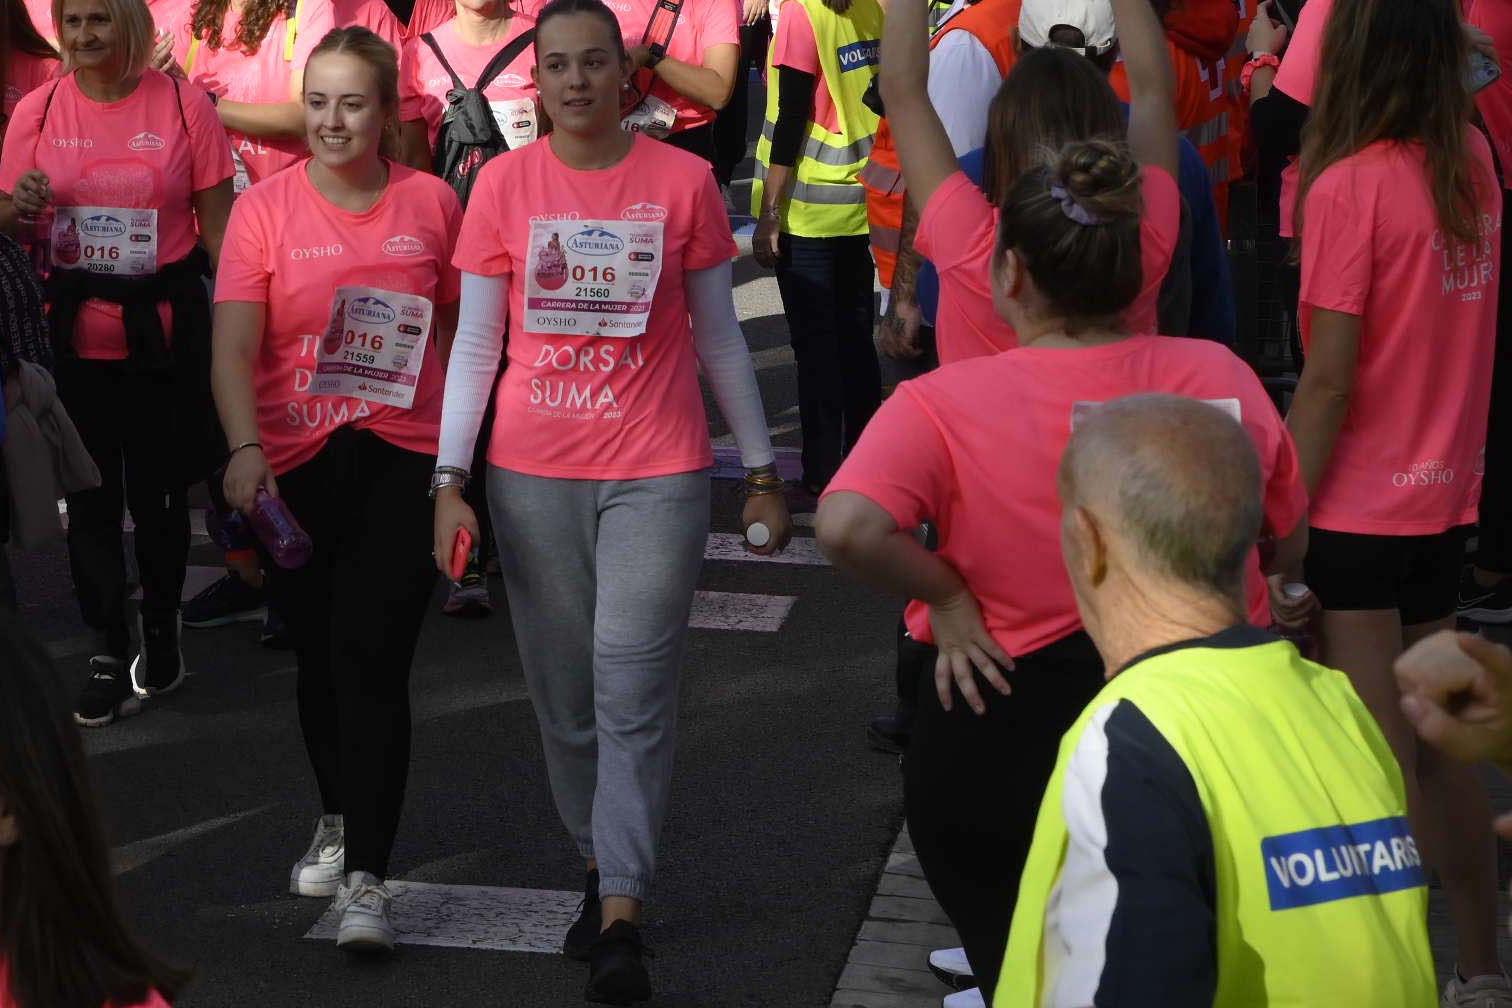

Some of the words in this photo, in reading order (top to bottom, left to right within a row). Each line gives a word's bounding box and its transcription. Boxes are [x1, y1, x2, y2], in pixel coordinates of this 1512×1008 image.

[83, 244, 120, 260] 016
[291, 243, 344, 261] OYSHO
[572, 238, 622, 252] ASTURIANA
[87, 262, 116, 273] 20280
[571, 265, 616, 282] 016
[575, 287, 610, 298] 21560
[540, 300, 576, 310] CARRERA
[576, 302, 589, 310] DE
[589, 302, 601, 310] LA
[601, 303, 627, 312] MUJER
[399, 309, 424, 320] SUMA
[537, 317, 577, 327] OYSHO
[343, 329, 384, 351] 016
[343, 350, 375, 365] 21559
[529, 376, 619, 409] SUMA
[287, 398, 371, 429] SUMA
[1392, 468, 1455, 487] OYSHO
